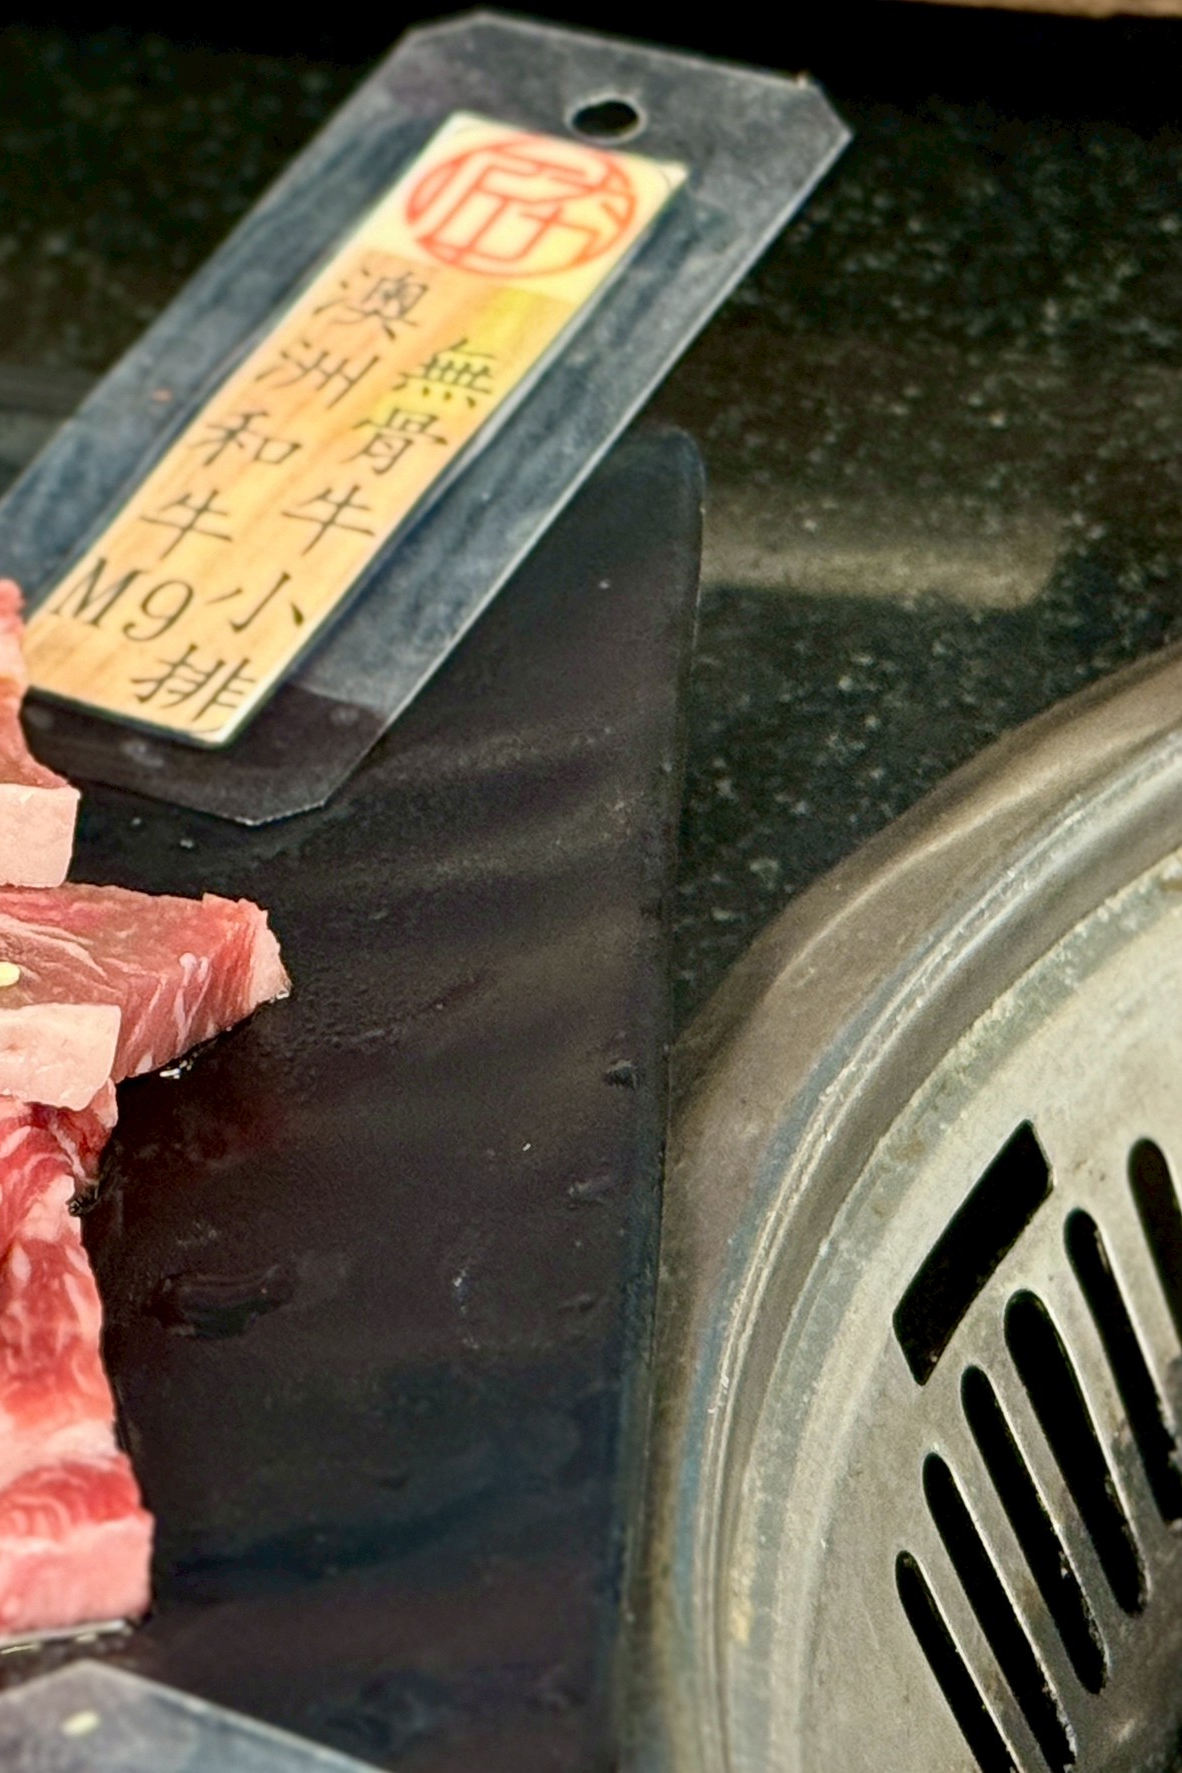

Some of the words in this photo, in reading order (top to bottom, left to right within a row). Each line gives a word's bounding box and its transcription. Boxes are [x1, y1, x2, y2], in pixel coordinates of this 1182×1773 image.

[131, 338, 496, 723] 無骨牛小排
